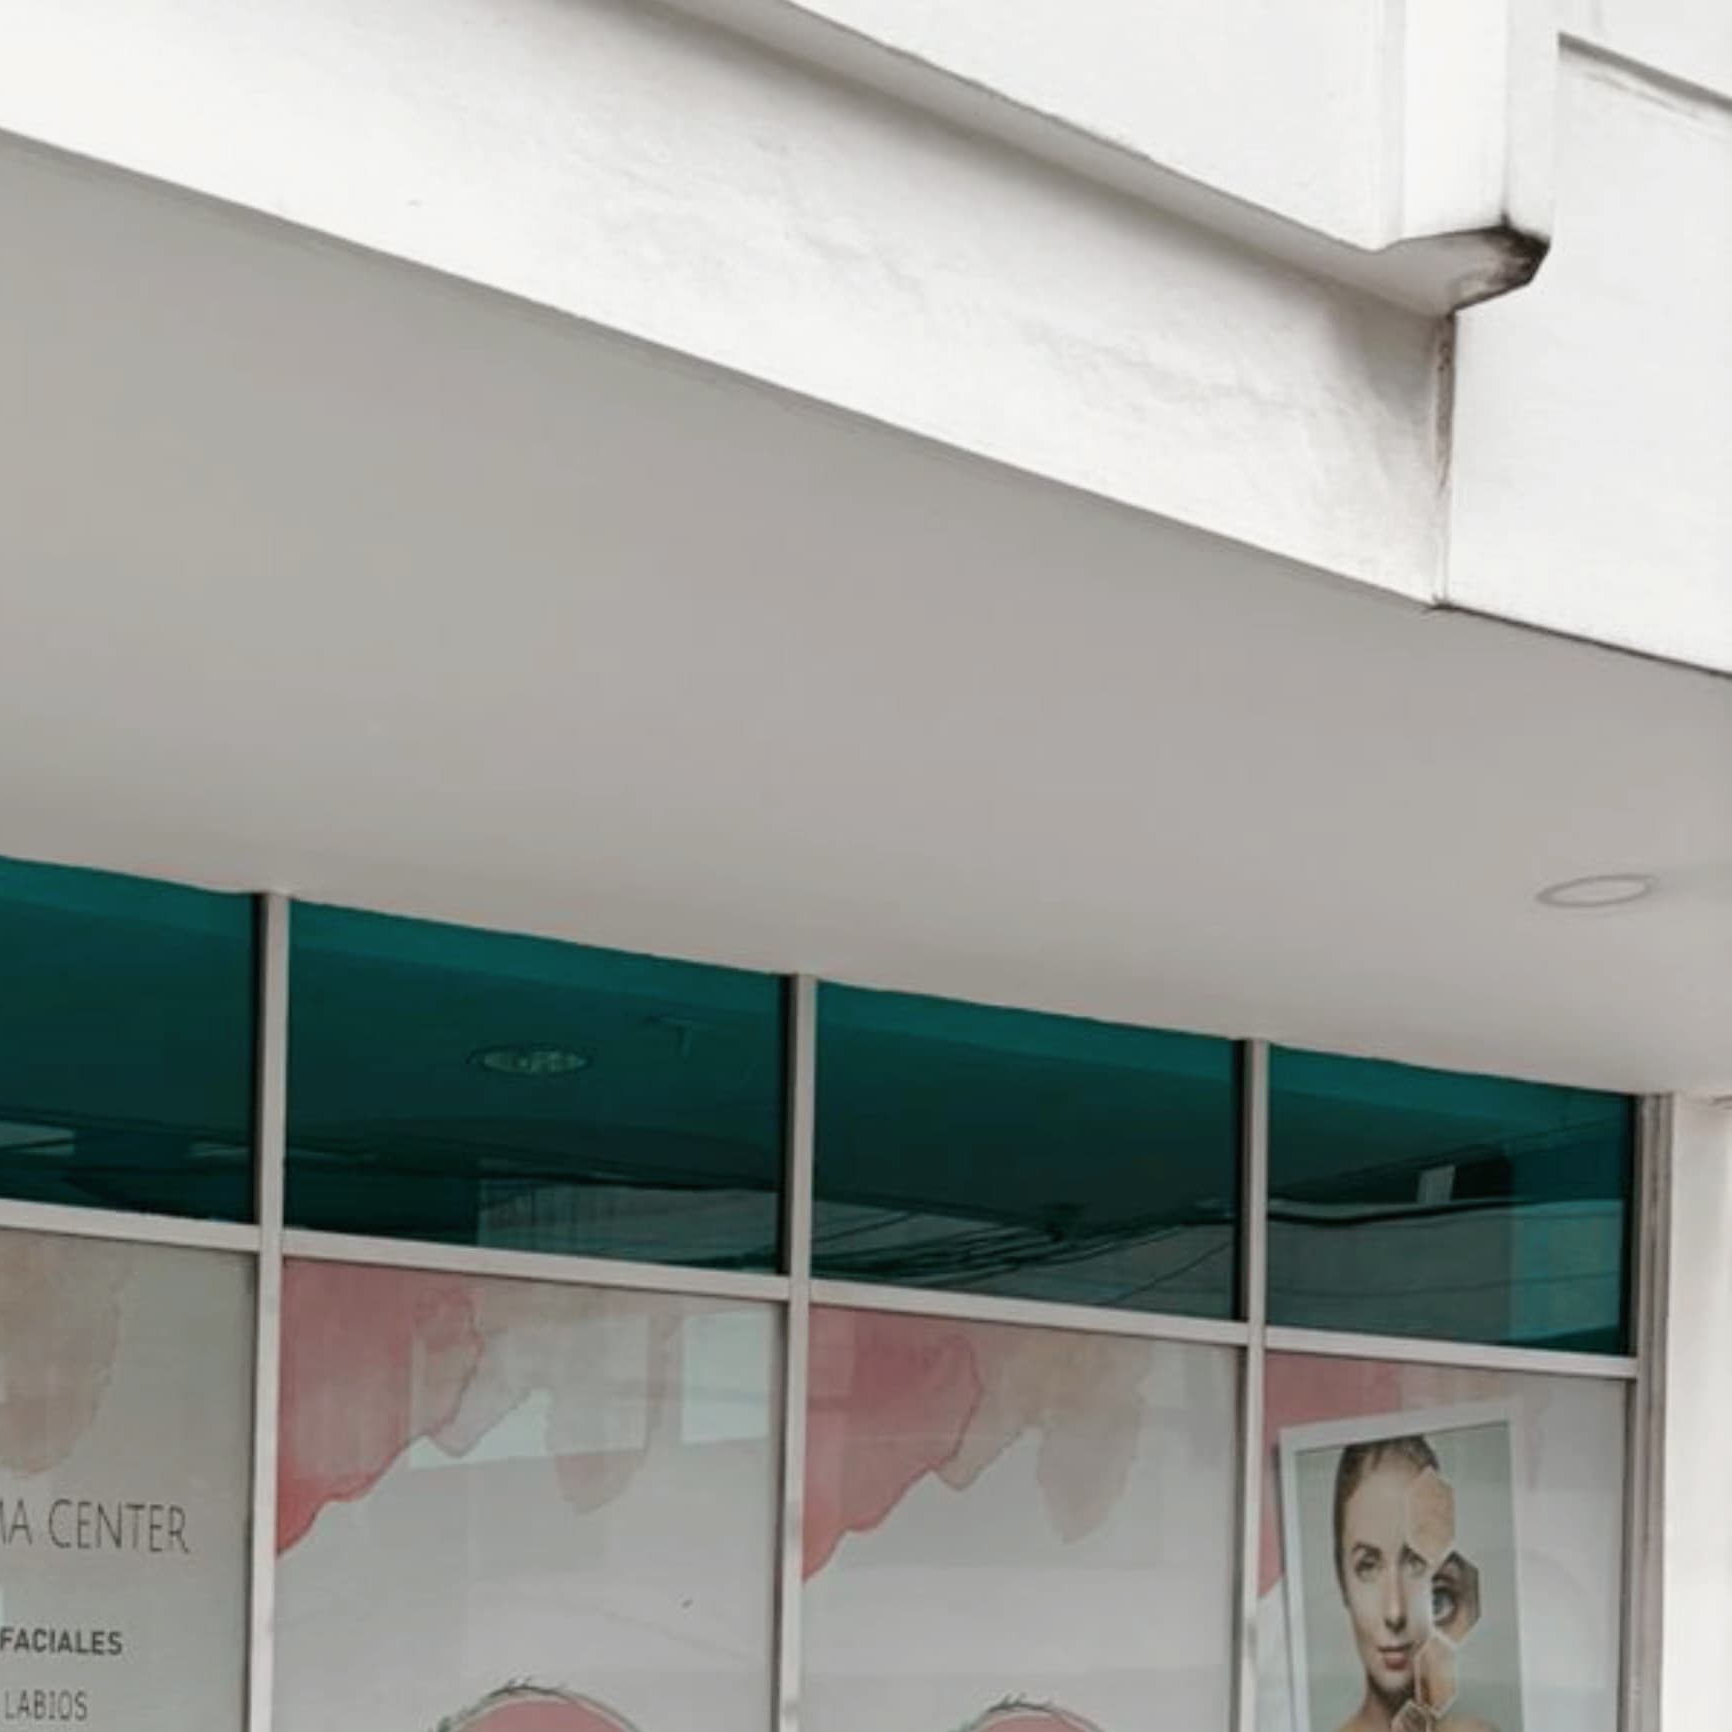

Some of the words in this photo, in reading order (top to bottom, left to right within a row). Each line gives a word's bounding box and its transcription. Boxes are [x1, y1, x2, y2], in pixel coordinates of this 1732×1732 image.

[48, 1498, 191, 1555] CENTER
[0, 1625, 123, 1656] FACIALES
[4, 1690, 88, 1721] LABIOS
